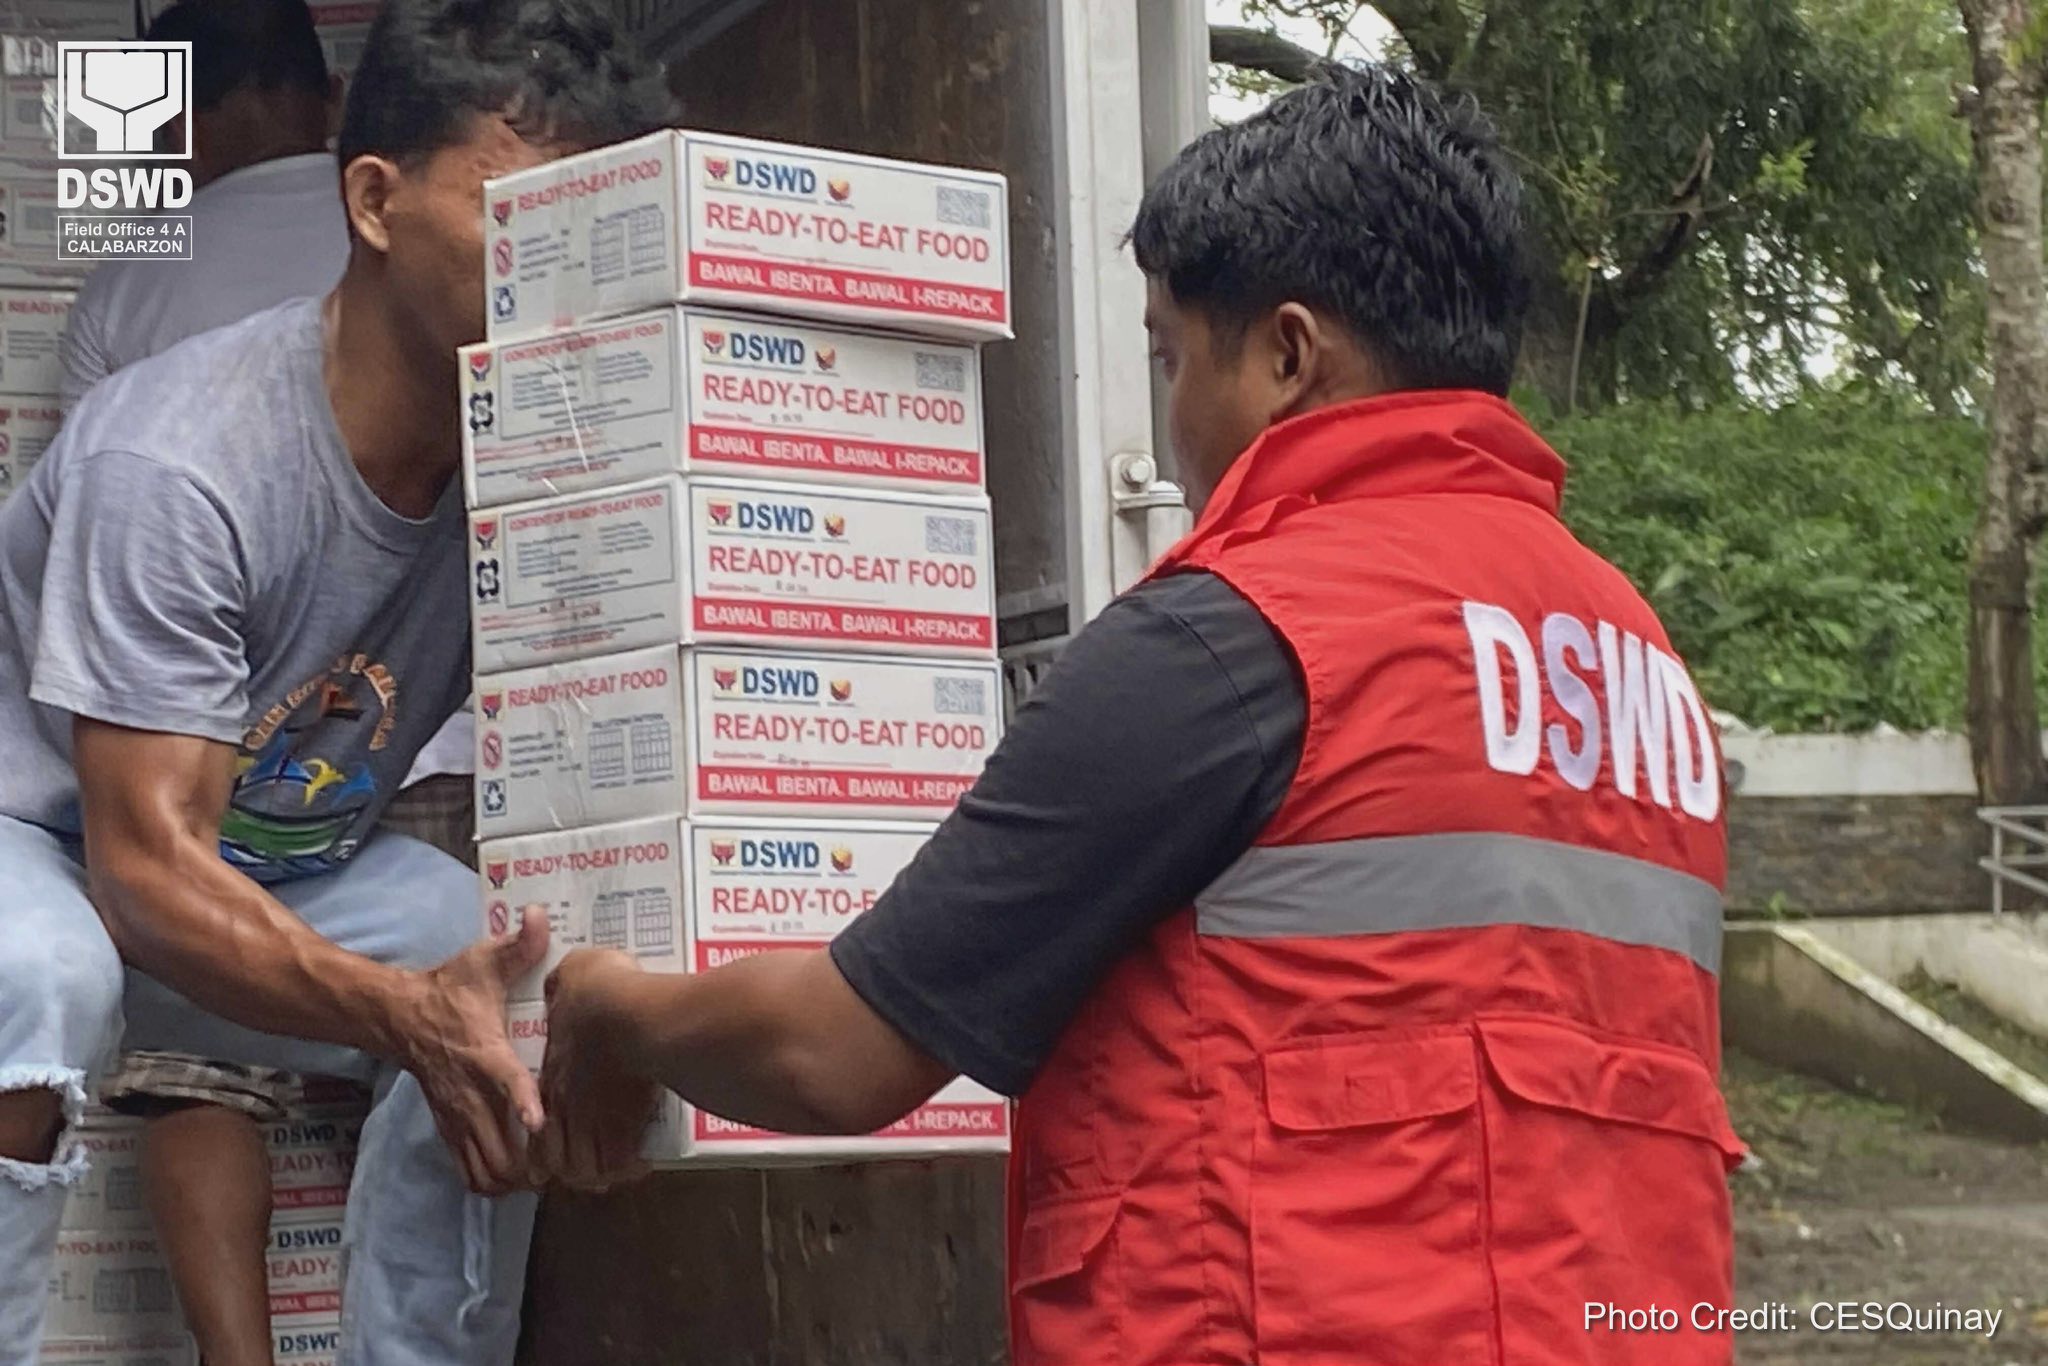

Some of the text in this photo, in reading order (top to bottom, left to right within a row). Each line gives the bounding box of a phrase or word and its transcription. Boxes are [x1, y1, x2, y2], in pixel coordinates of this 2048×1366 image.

[619, 159, 663, 184] FOOD
[736, 160, 816, 195] DSWD
[706, 202, 909, 252] READY-TO-EAT
[917, 229, 990, 263] FOOD
[699, 260, 765, 287] BAWAL
[845, 279, 909, 304] BAWAL
[730, 332, 805, 365] DSWD
[703, 374, 965, 425] READY-TO-EAT FOOD
[698, 432, 761, 457] BAWAL
[834, 447, 892, 470] BAWAL
[737, 502, 814, 533] DSWD
[708, 545, 976, 589] READY-TO-EAT FOOD
[703, 604, 768, 627] BAWAL
[842, 615, 903, 636] BAWAL
[508, 668, 667, 708] READY-TO-EAT FOOD
[742, 666, 819, 697] DSWD
[1462, 600, 1720, 822] DSWD
[714, 712, 985, 750] READY-TO-EAT FOOD
[708, 774, 773, 794] BAWAL
[848, 781, 909, 799] BAWAL
[913, 780, 974, 801] I-REPA
[513, 842, 669, 878] READY-TO-EAT FOOD
[740, 839, 820, 868] DSWD
[712, 887, 878, 915] READY-TO-E
[274, 1124, 336, 1144] DSWD
[278, 1228, 341, 1248] DSWD
